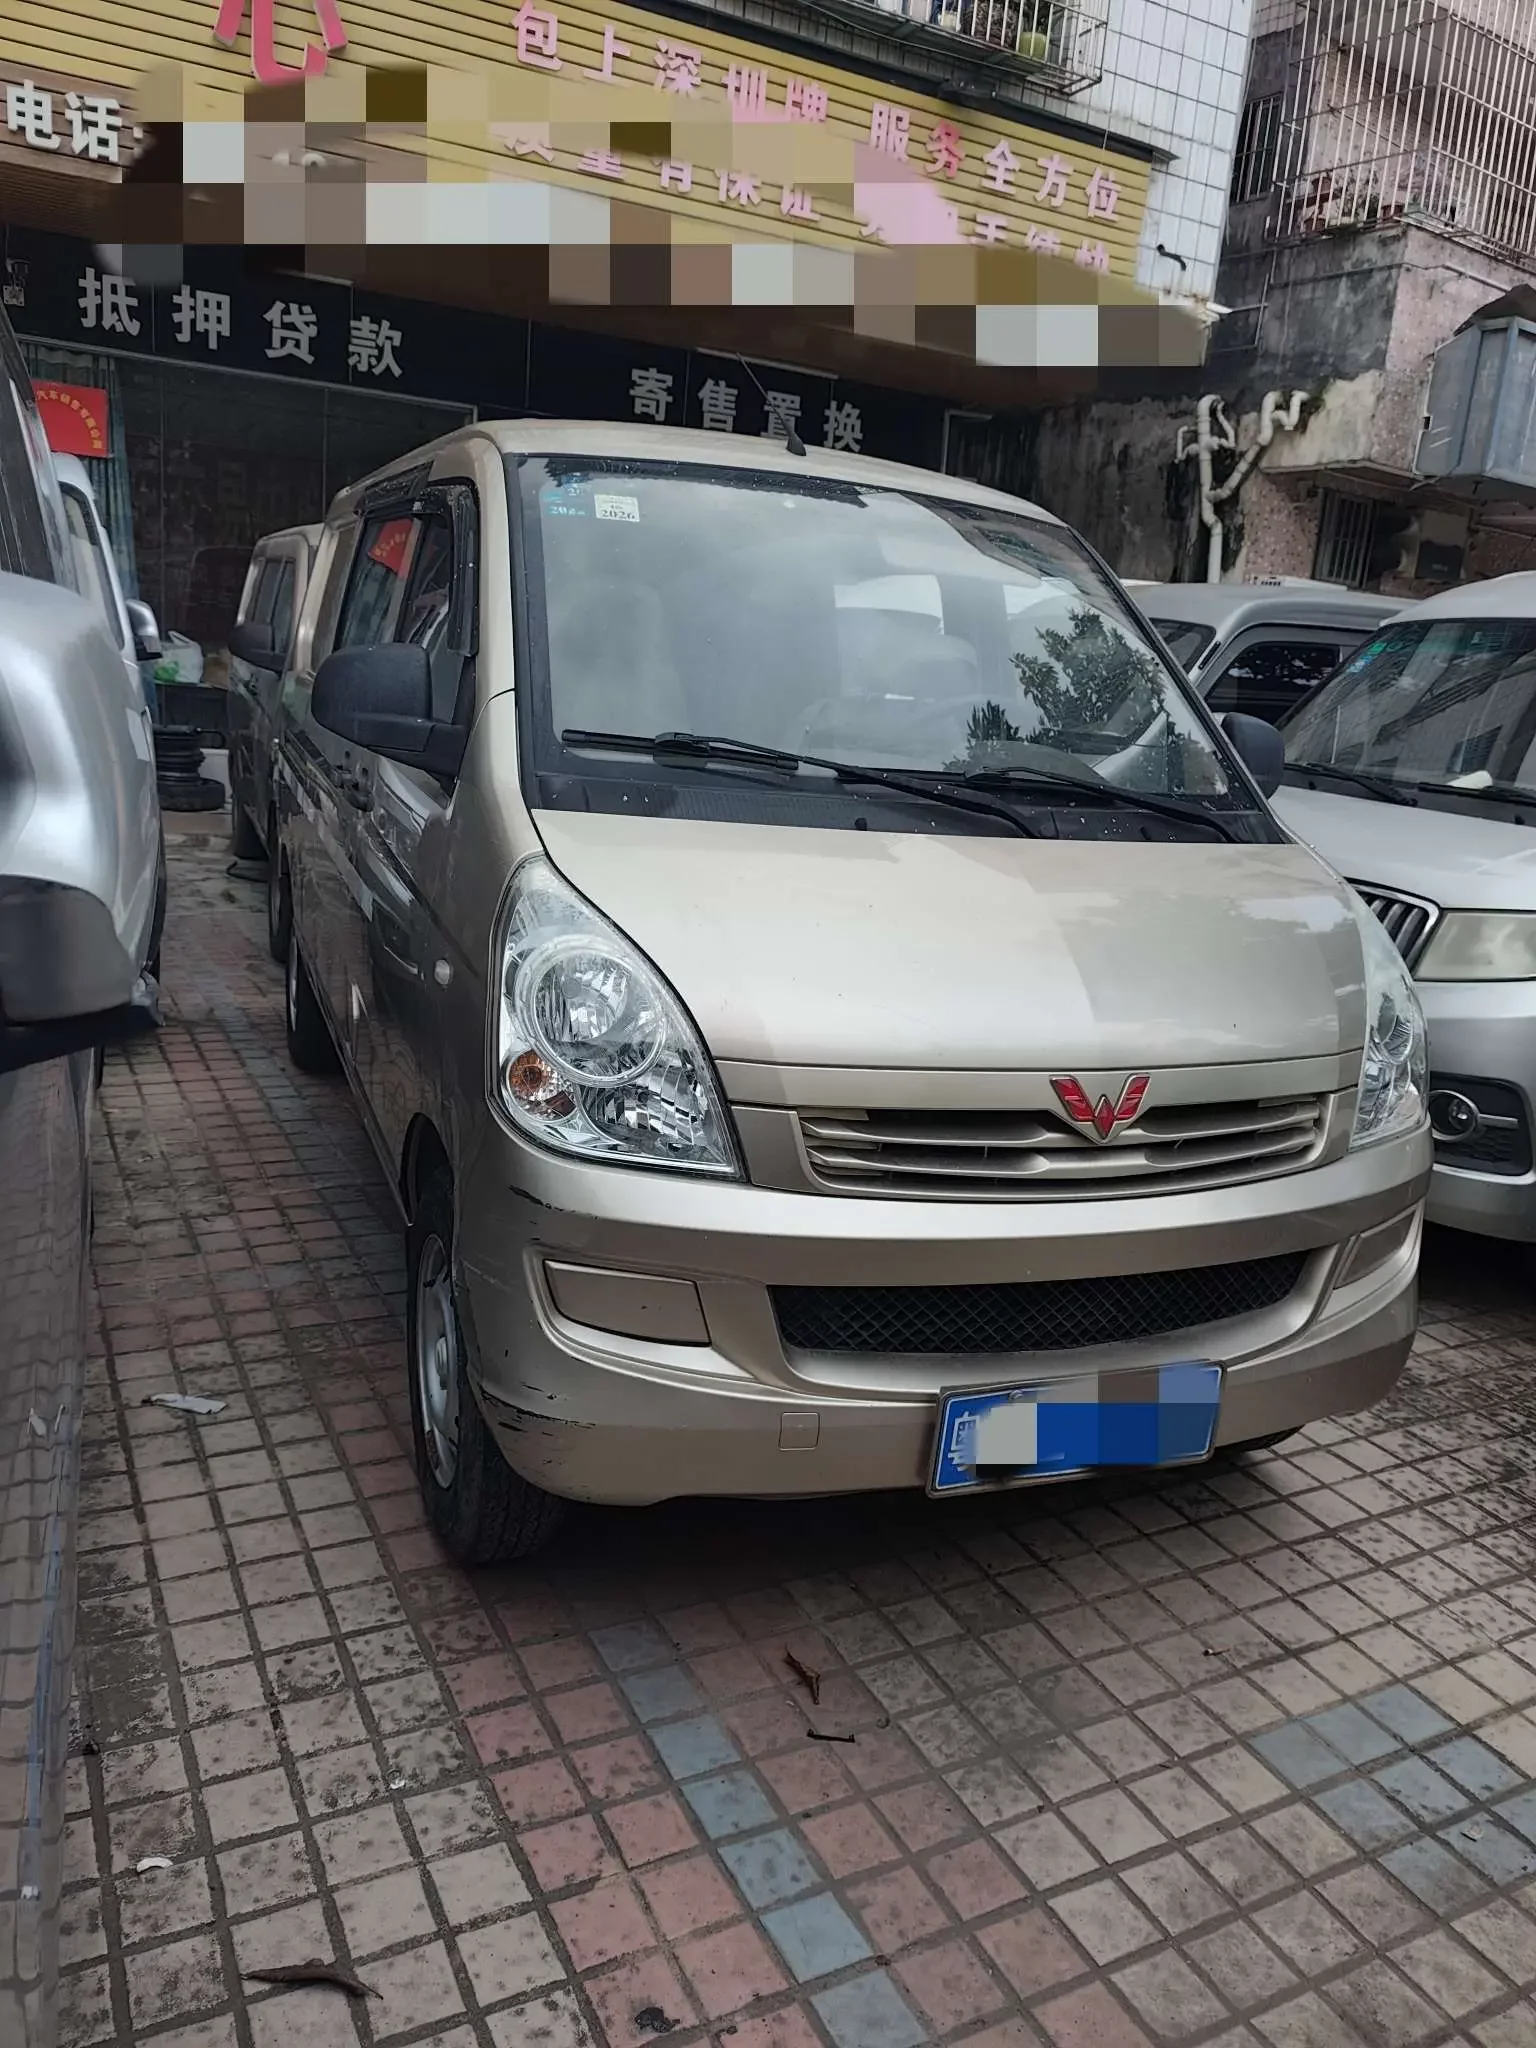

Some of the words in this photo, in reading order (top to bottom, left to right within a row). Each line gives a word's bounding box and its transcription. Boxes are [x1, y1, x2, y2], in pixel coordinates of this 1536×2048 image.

[870, 100, 1122, 223] 服务全方位
[78, 267, 402, 377] 抵押贷款
[629, 368, 864, 452] 寄售置换
